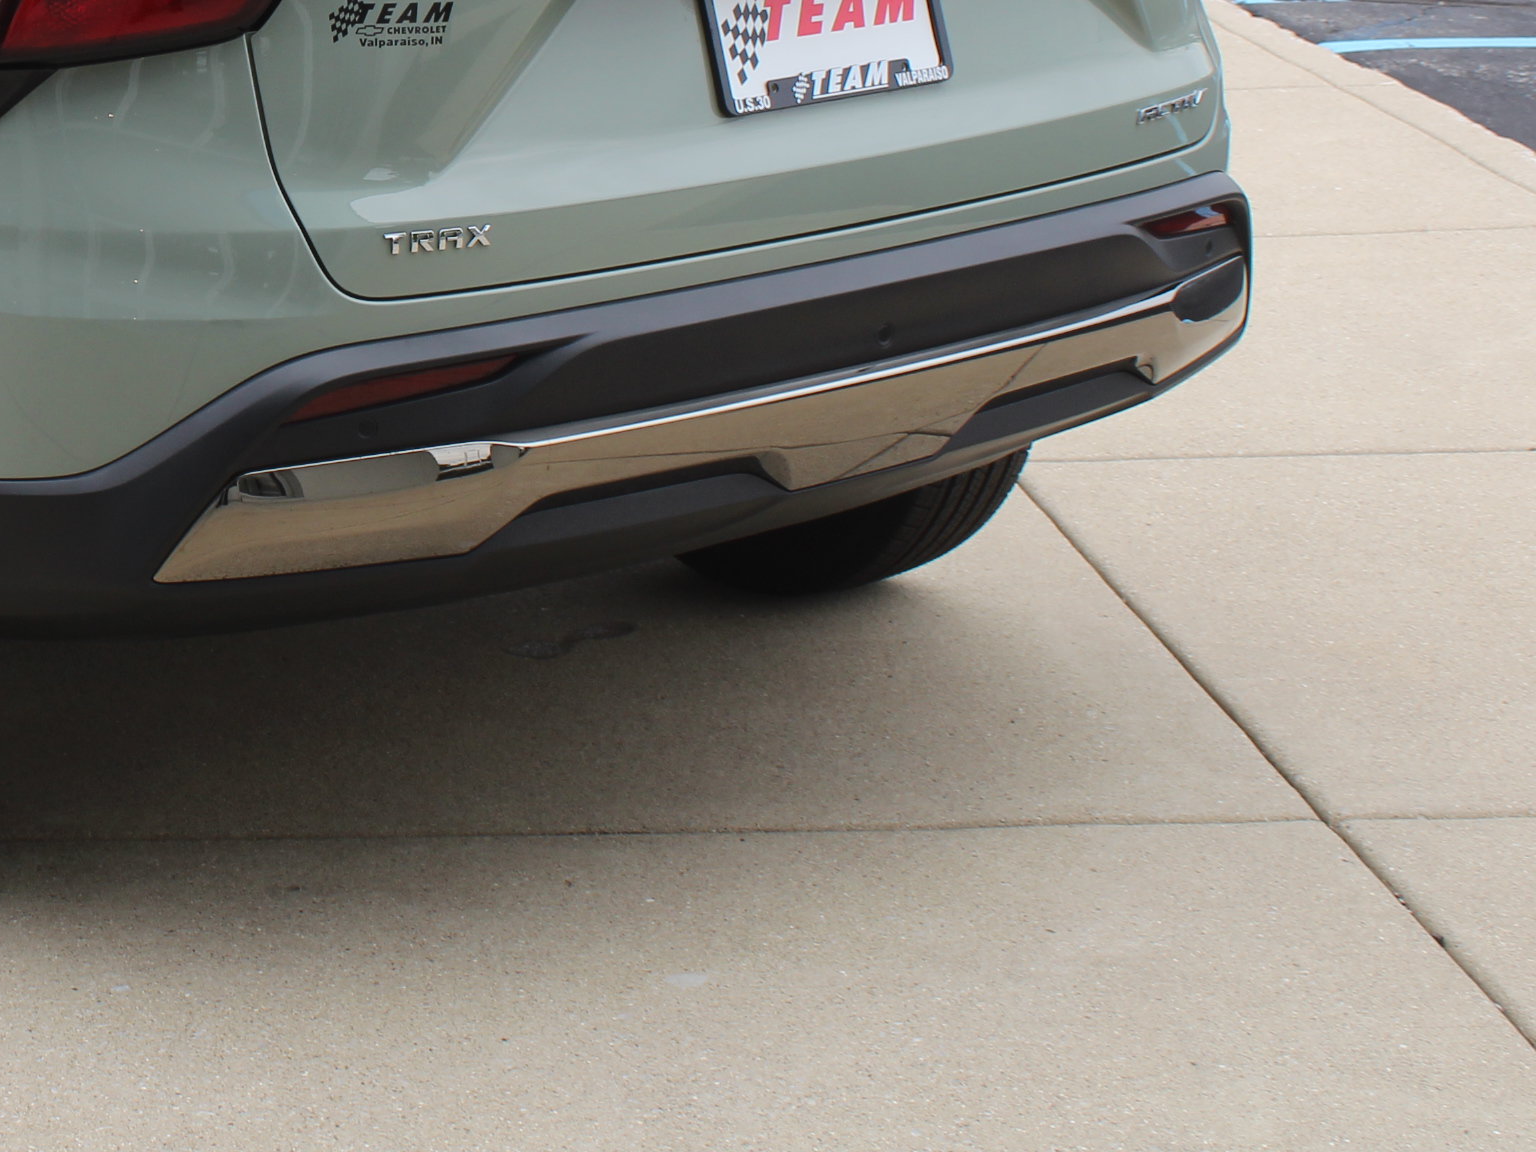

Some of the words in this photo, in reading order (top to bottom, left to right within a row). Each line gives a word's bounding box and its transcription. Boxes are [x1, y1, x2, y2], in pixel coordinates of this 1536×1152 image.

[357, 1, 454, 24] TEAM
[387, 25, 447, 35] CHEVROLET
[359, 37, 429, 48] Valparaiso,
[431, 36, 443, 46] IN
[811, 59, 890, 97] TEAM
[894, 65, 950, 87] VALPARAISO
[734, 95, 772, 114] U.S.30
[383, 223, 492, 256] TRAX
